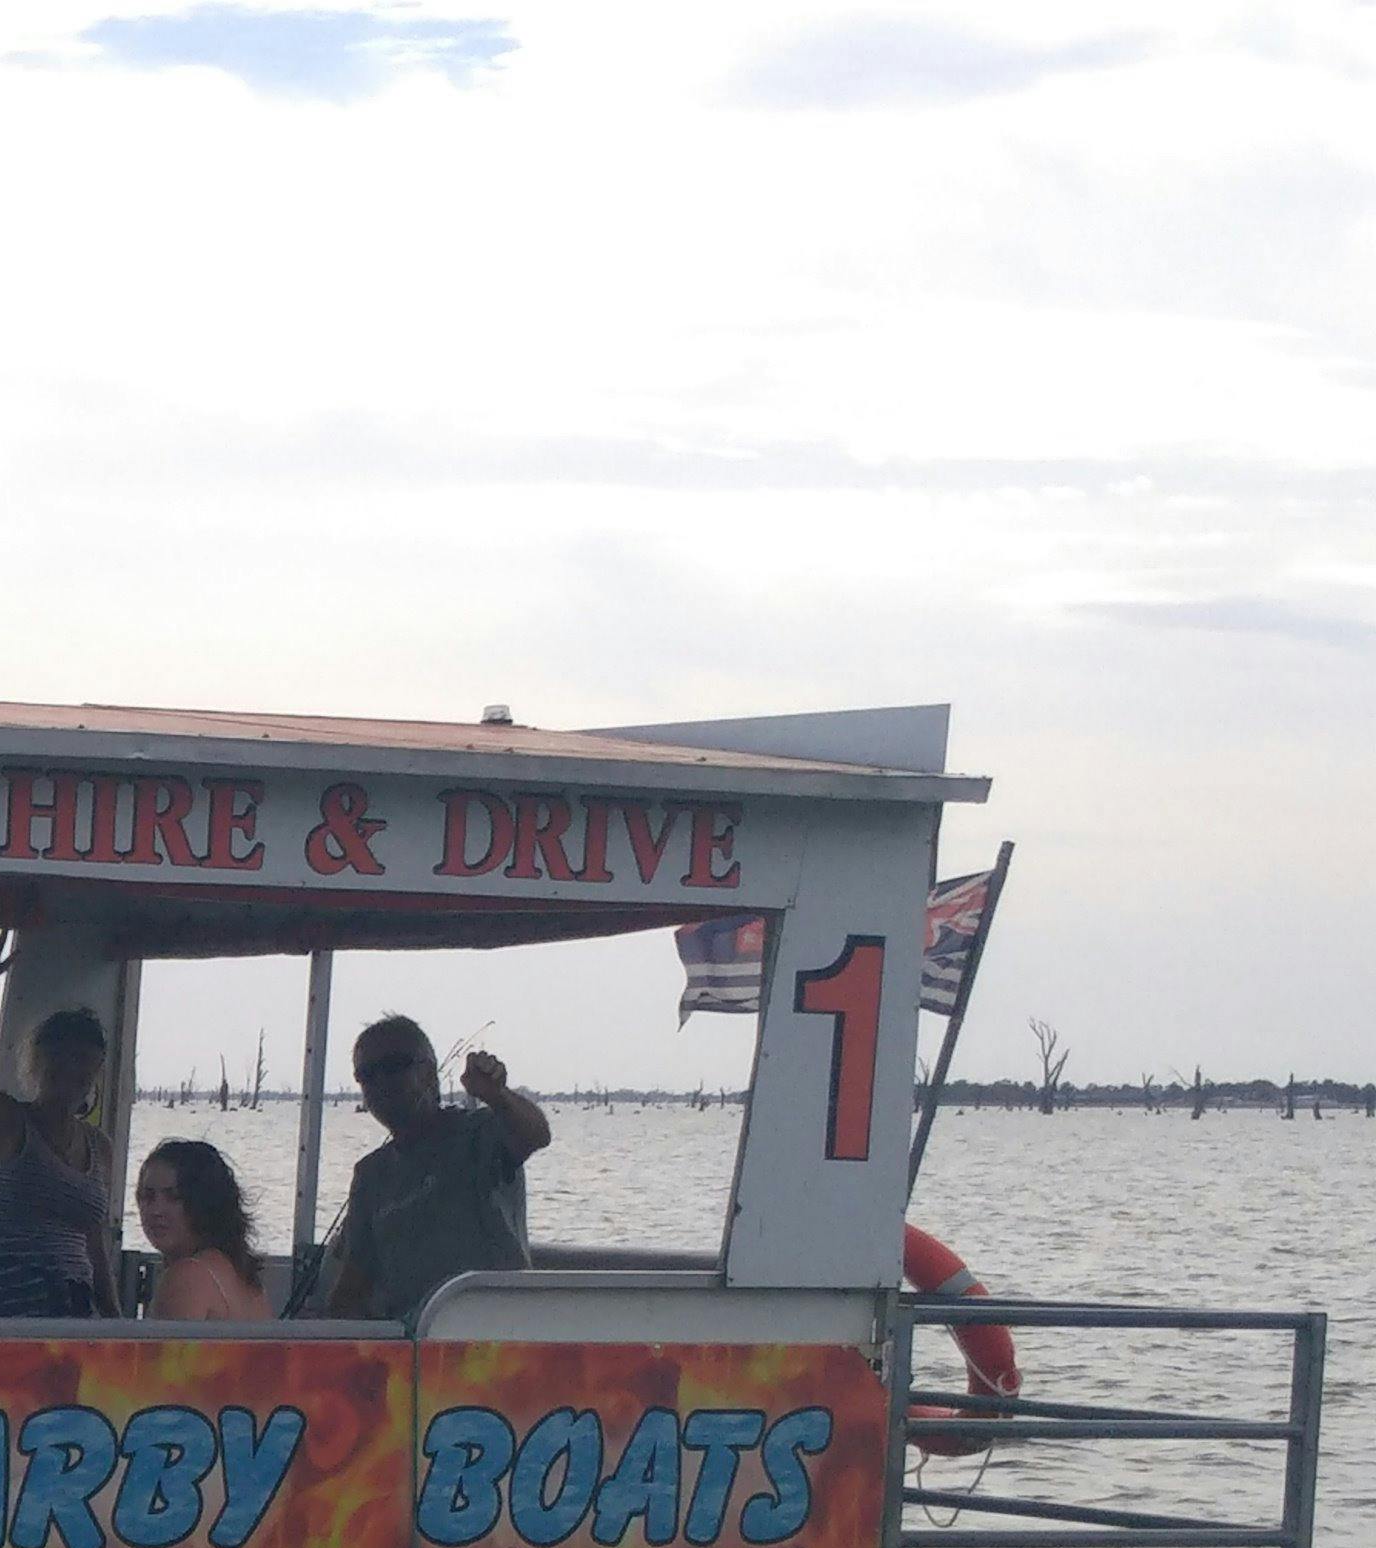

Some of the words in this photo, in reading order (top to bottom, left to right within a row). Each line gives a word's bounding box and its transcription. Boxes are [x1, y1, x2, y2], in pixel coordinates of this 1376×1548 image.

[305, 782, 387, 877] &
[435, 788, 742, 889] DRIVE
[793, 934, 886, 1162] 1
[416, 1406, 834, 1548] BOATS
